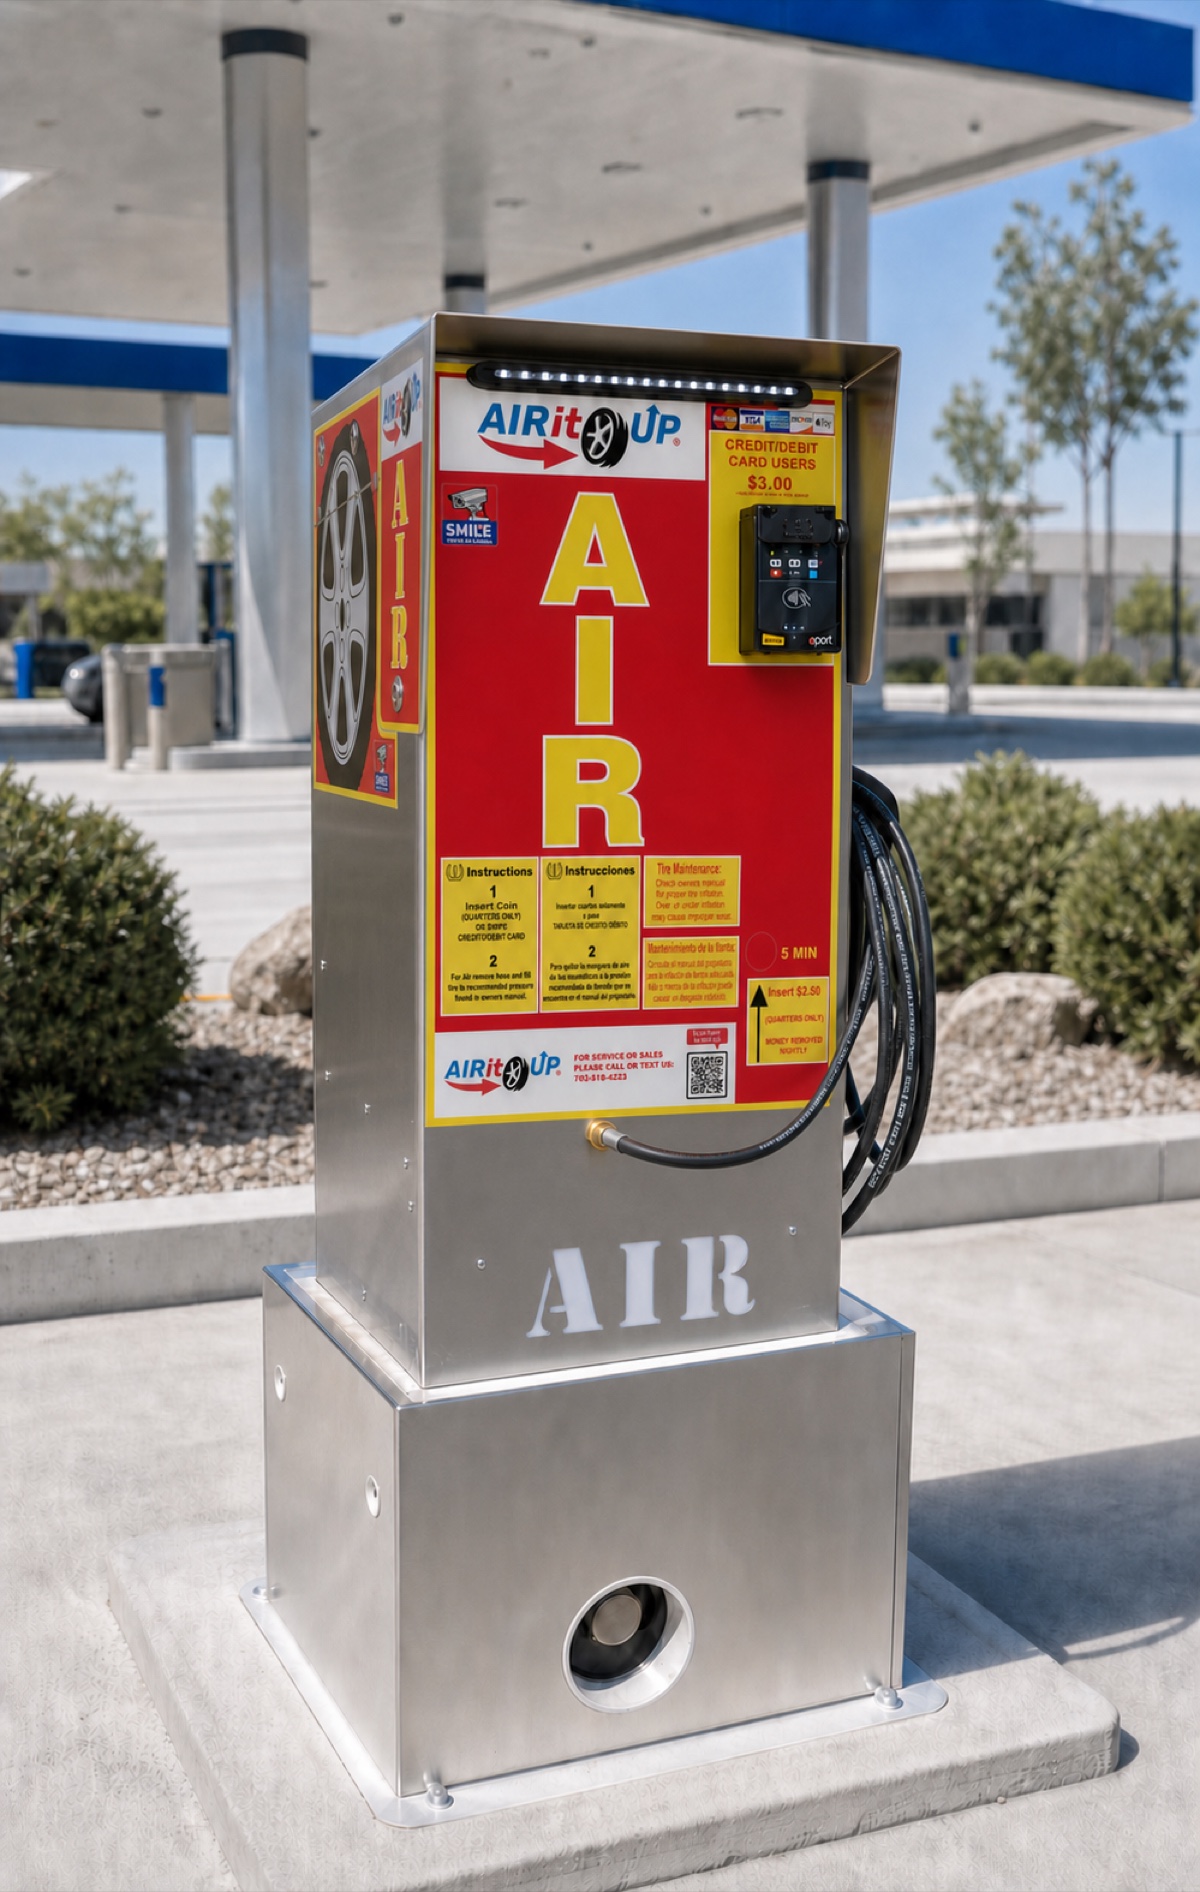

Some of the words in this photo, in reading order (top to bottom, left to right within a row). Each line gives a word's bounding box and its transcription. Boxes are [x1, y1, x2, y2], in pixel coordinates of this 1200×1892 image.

[725, 438, 818, 454] CREDIT/DEBIT
[729, 455, 767, 468] CARD
[771, 457, 817, 470] USERS
[748, 474, 792, 490] $3.00
[446, 523, 492, 538] SMILE
[539, 491, 650, 848] AIR
[467, 865, 533, 877] Instructions
[565, 864, 636, 876] Instrucciones
[657, 862, 671, 875] Tire
[489, 884, 497, 898] 1
[587, 884, 595, 898] 1
[465, 902, 494, 911] Insert
[496, 901, 518, 910] Coin
[588, 945, 596, 957] 2
[781, 947, 789, 960] 5
[793, 947, 818, 959] MIN
[489, 955, 497, 967] 2
[768, 987, 794, 997] Insert
[796, 986, 821, 998] $2.50
[591, 1052, 625, 1061] SERVICE
[573, 1064, 603, 1072] PLEASE
[626, 1062, 639, 1070] OR
[639, 1061, 659, 1069] TEXT
[525, 1234, 756, 1338] AIR
